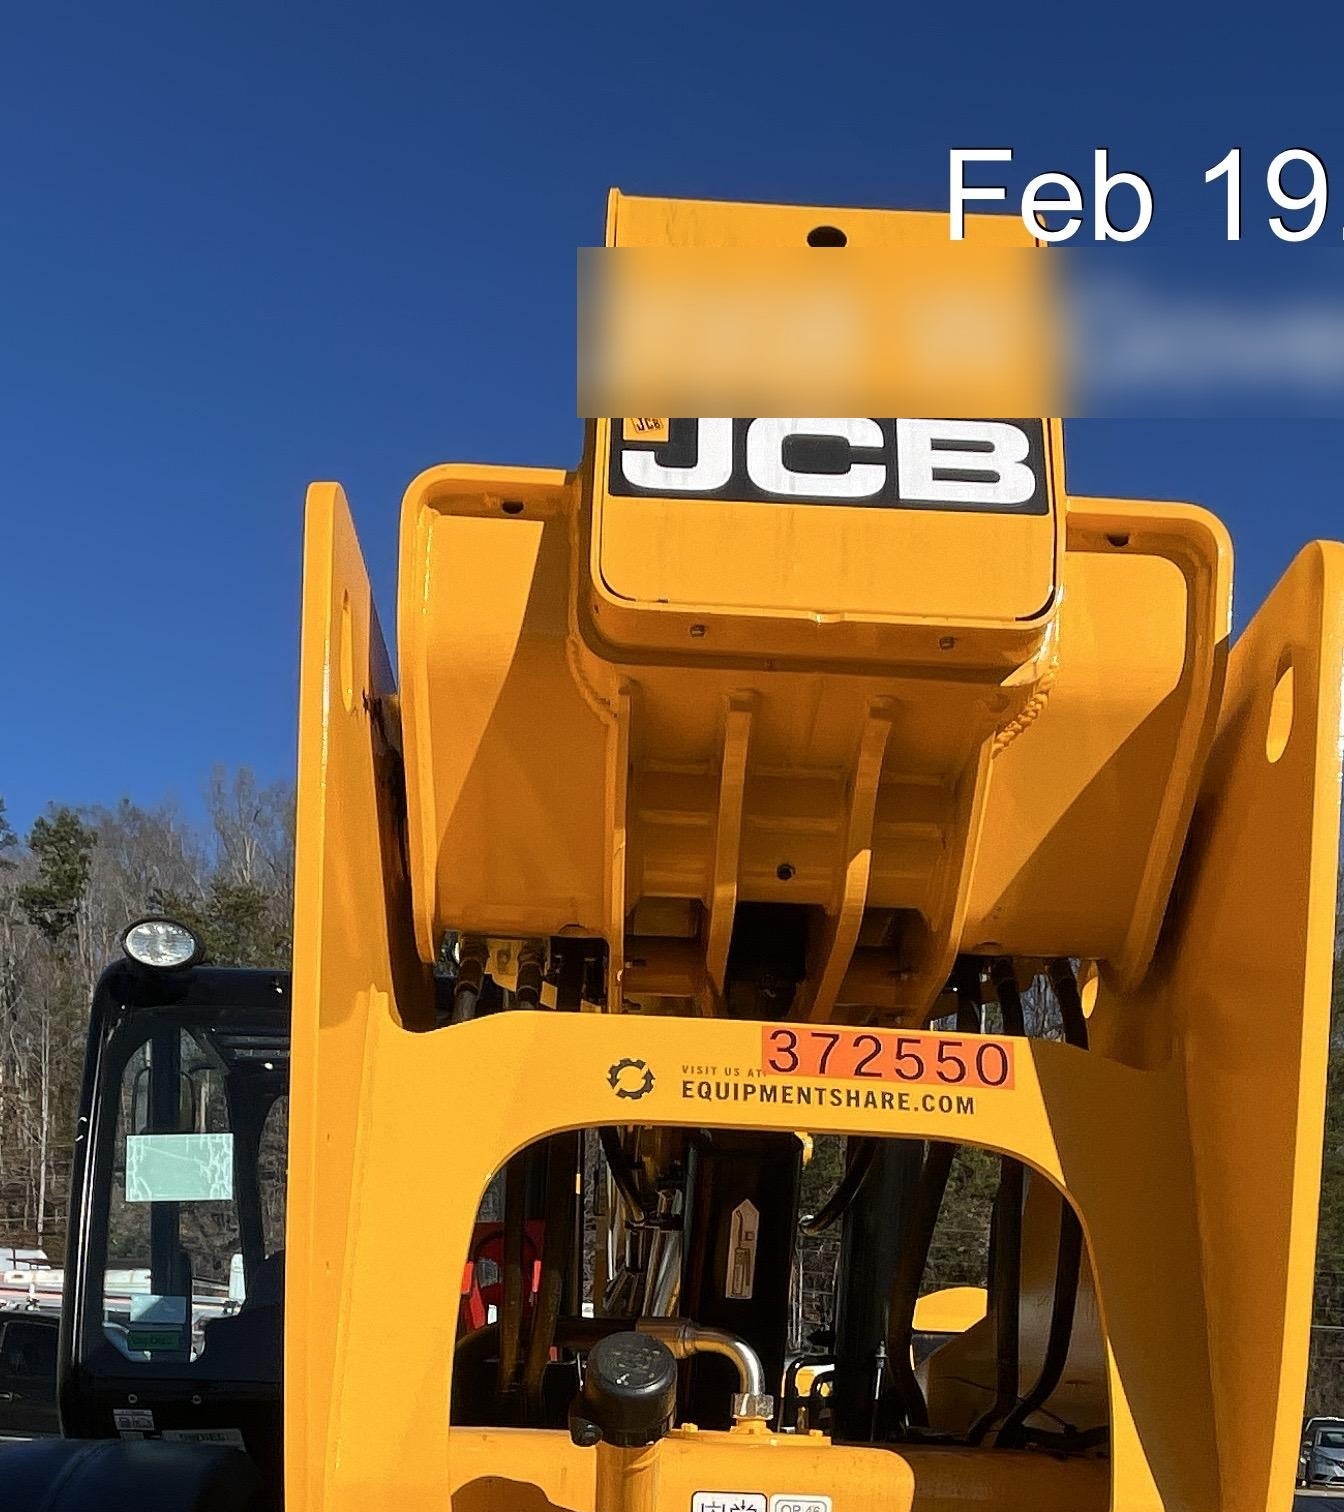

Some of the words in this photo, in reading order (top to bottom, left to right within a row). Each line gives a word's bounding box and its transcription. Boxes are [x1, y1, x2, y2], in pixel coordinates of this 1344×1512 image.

[621, 418, 1036, 505] JCB
[682, 1064, 717, 1075] VISIT
[724, 1067, 740, 1077] US
[767, 1029, 1007, 1087] 372550
[682, 1079, 976, 1116] EQUIPMENTSHARE.COM
